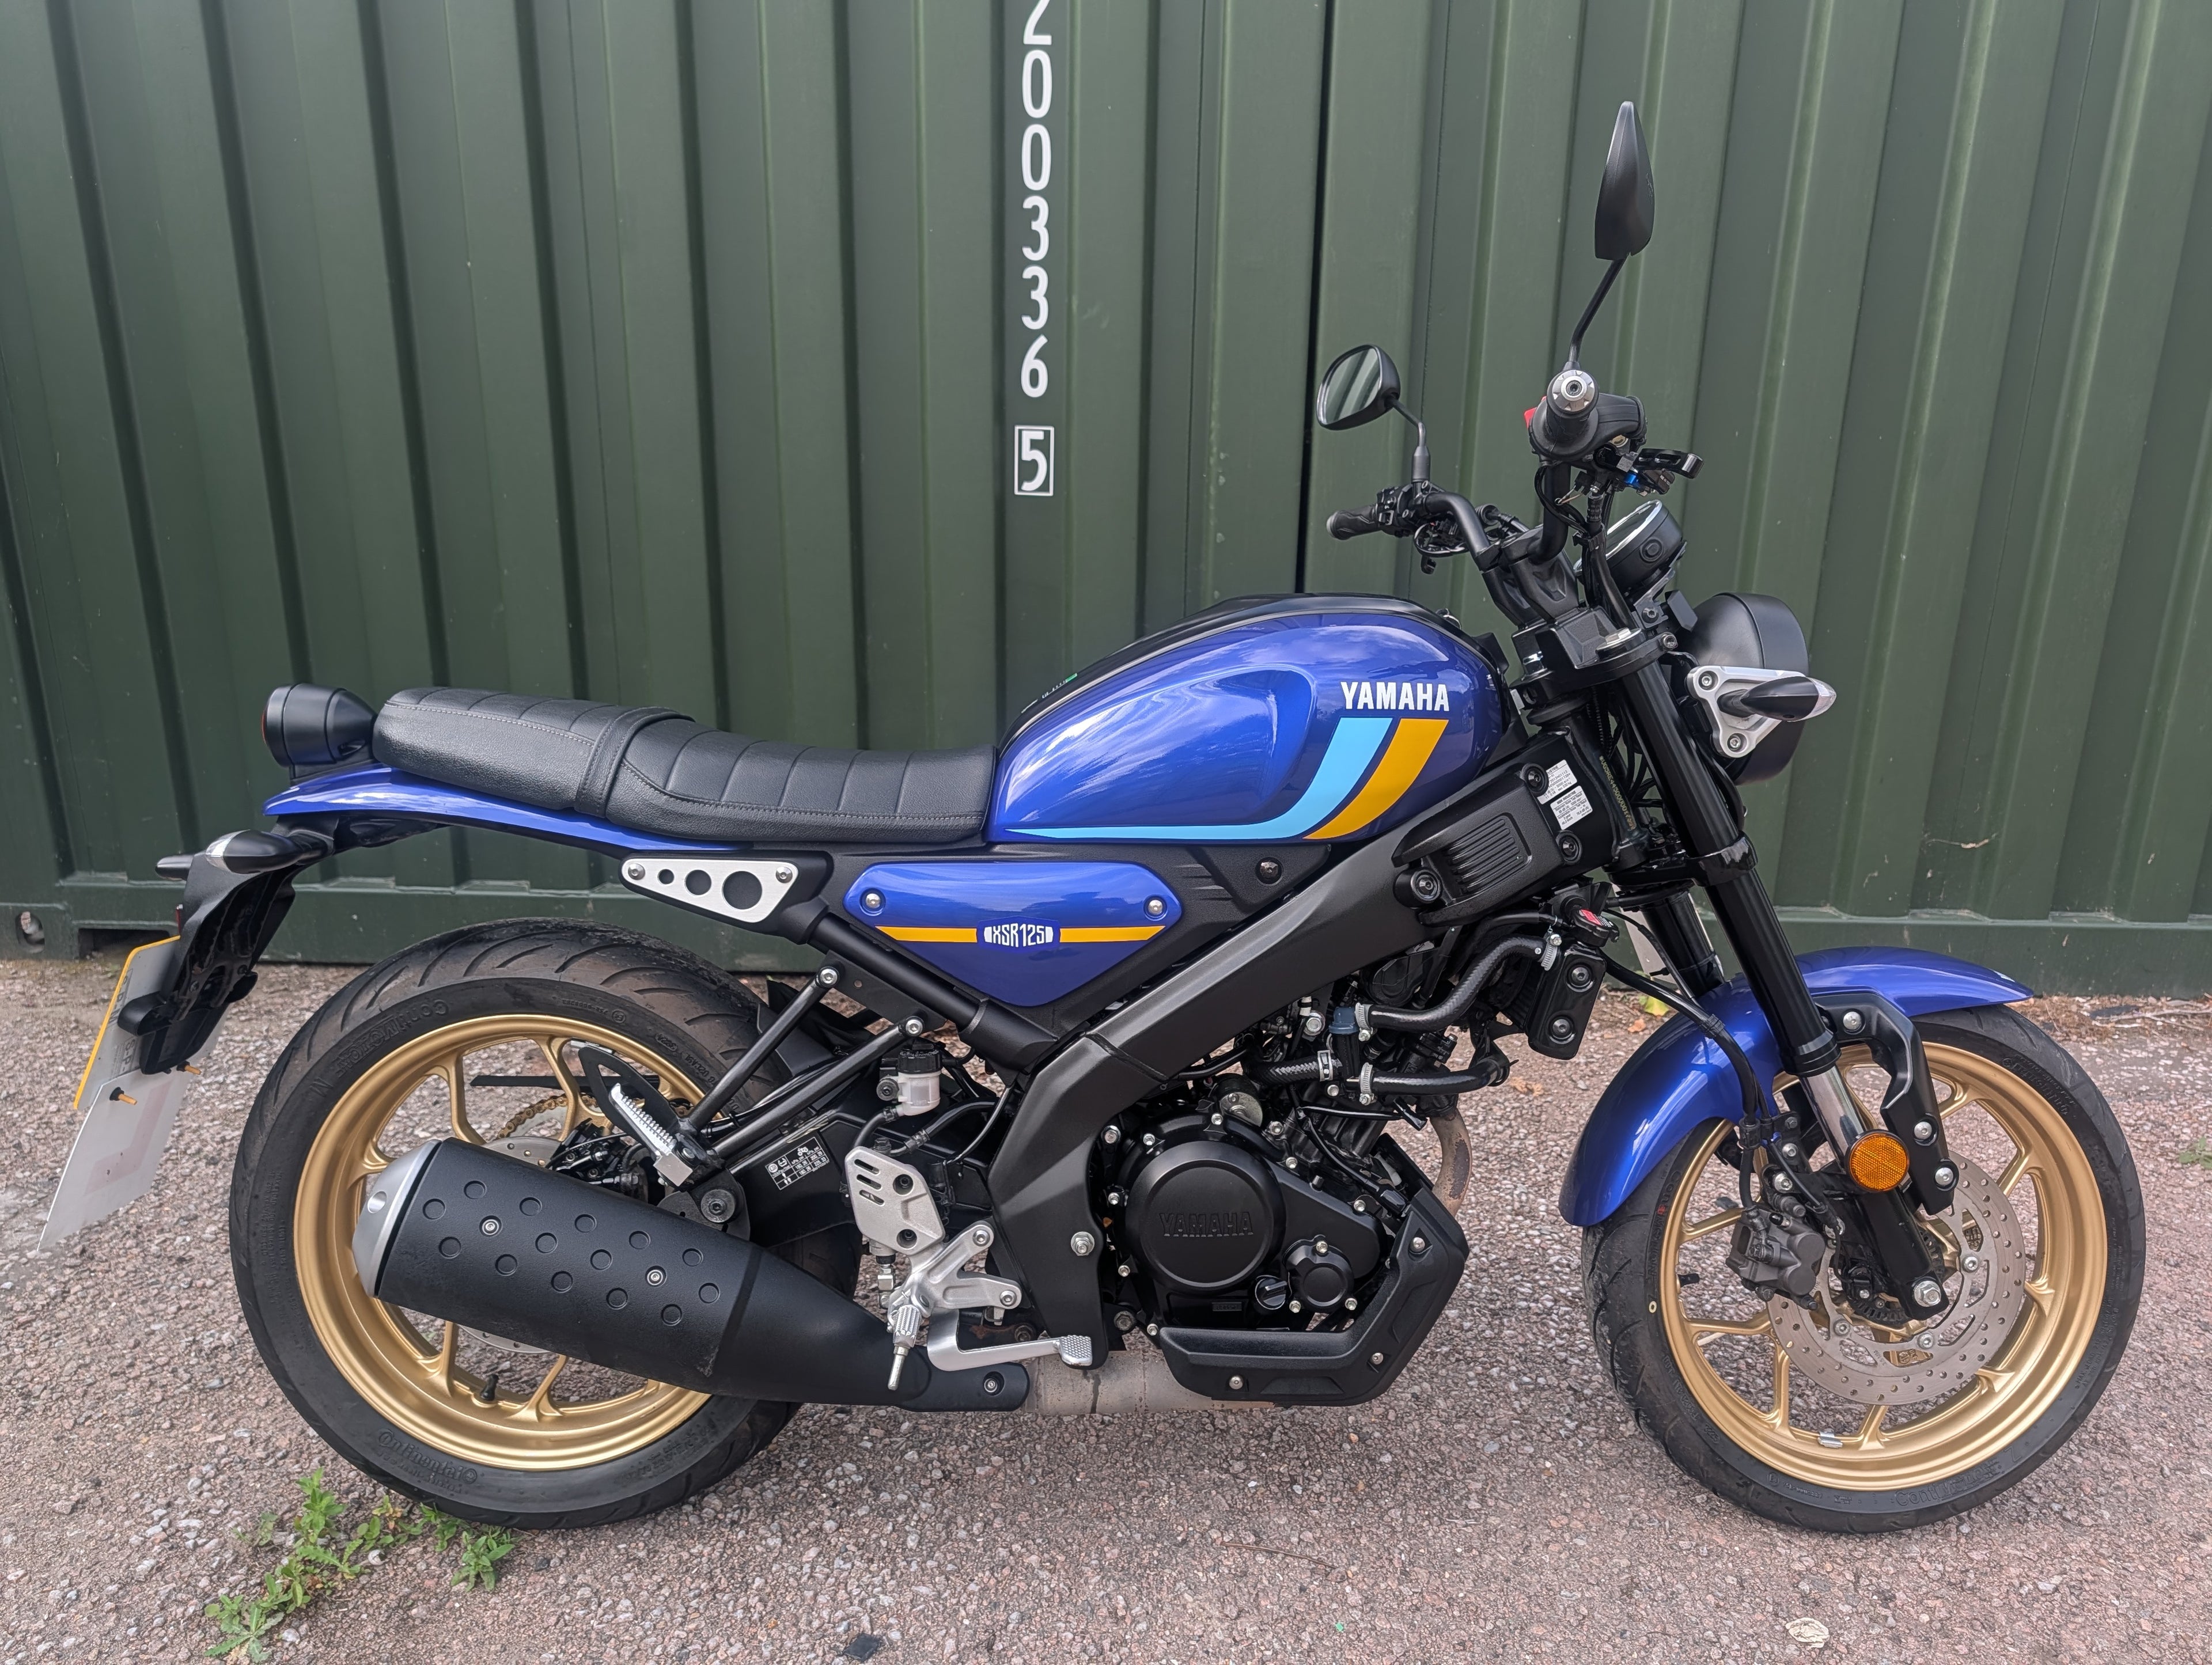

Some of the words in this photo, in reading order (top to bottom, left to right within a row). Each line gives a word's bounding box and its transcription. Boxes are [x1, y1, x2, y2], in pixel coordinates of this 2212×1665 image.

[1340, 681, 1449, 712] YAMAHA
[993, 923, 1044, 947] XSR125
[1160, 1212, 1253, 1237] YAMAHA
